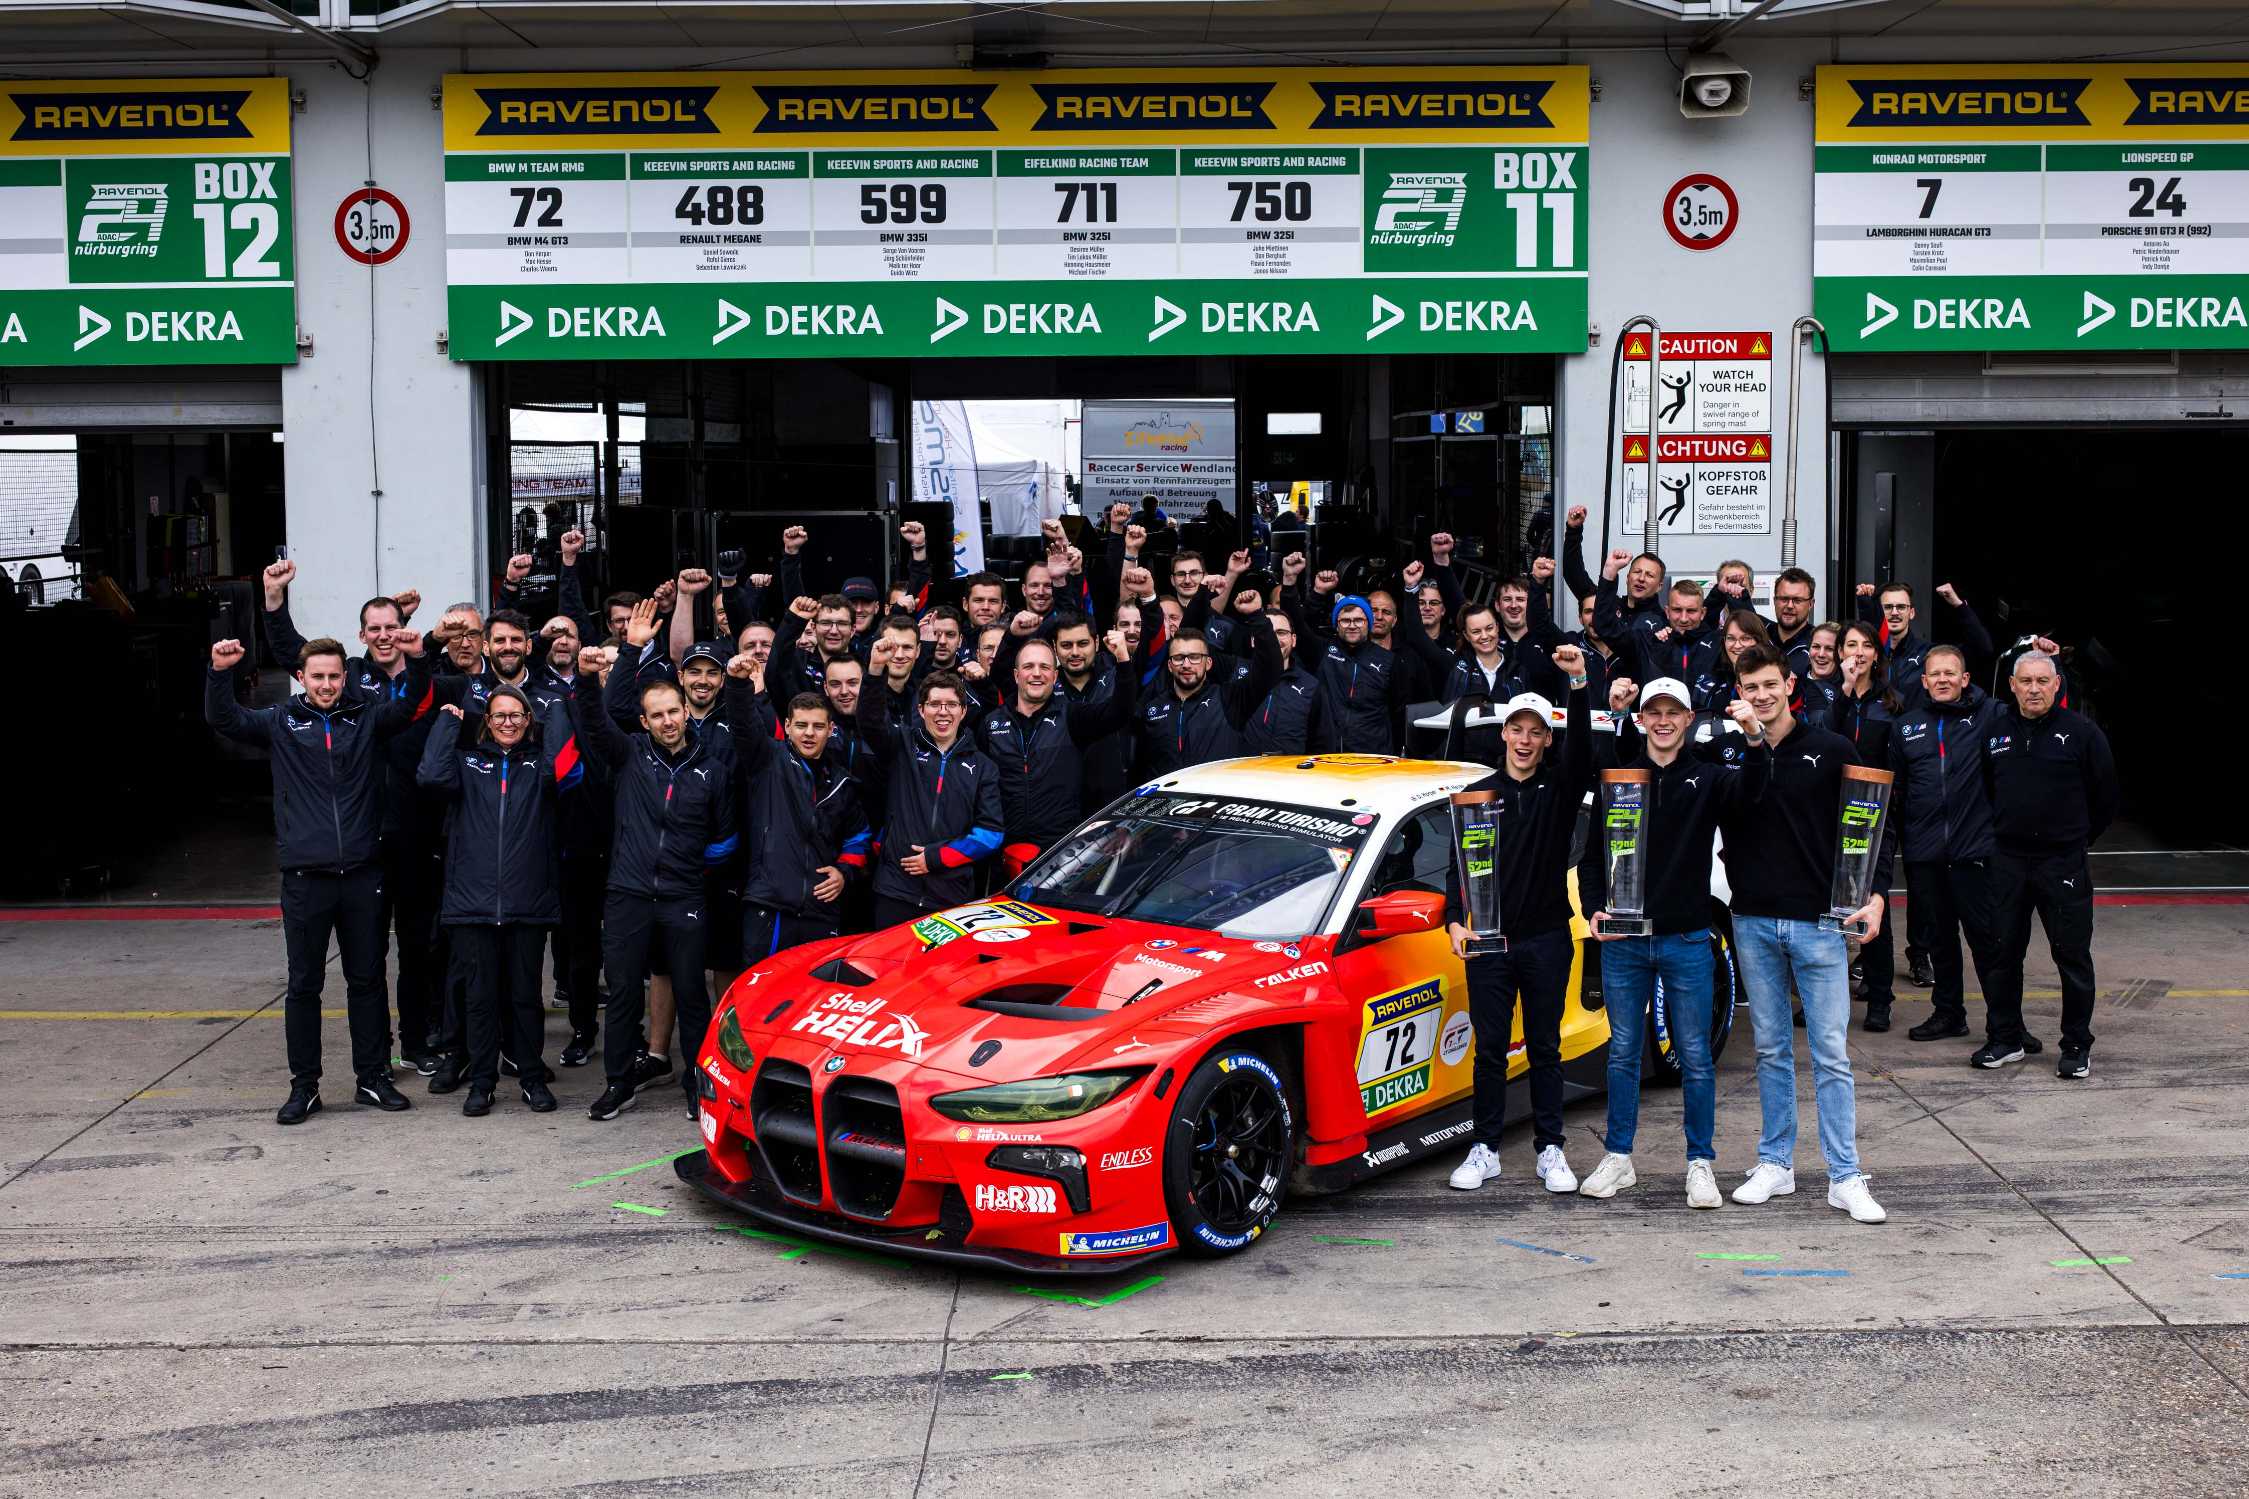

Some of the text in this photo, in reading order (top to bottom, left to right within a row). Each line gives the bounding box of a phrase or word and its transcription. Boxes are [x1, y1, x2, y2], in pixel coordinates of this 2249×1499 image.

[501, 100, 696, 123] RAVENOL
[779, 97, 974, 121] RAVENOL
[1057, 95, 1252, 118] RAVENOL
[1335, 94, 1531, 117] RAVENOL
[1873, 92, 2068, 114] RAVENOL
[2150, 90, 2249, 113] RAVE
[34, 105, 229, 128] RAVENOL
[489, 163, 584, 173] BMW M TEAM RMG
[644, 161, 795, 172] KEEEVIN SPORTS AND RACING
[828, 159, 978, 170] KEEEVIN SPORTS AND RACING
[1025, 158, 1148, 169] EIFELKIND RACING TEAM
[1195, 156, 1346, 168] KEEEVIN SPORTS AND RACING
[1873, 153, 1986, 165] KONRAD MOTORSPORT
[2122, 152, 2194, 163] LIONSPEED GP
[194, 163, 277, 199] BOX
[1495, 153, 1577, 189] BOX
[98, 186, 162, 195] RAVENOL
[1228, 181, 1311, 222] 750
[1916, 179, 1942, 219] 7
[2129, 177, 2186, 217] 24
[510, 187, 563, 227] 72
[675, 186, 763, 225] 488
[861, 184, 946, 223] 599
[1055, 182, 1117, 223] 711
[1375, 189, 1466, 231] 24
[1679, 196, 1722, 227] 3,5m
[78, 200, 168, 241] 24
[350, 211, 395, 242] 3,5m
[1507, 193, 1574, 268] 11
[2102, 225, 2211, 237] PORSCHE 911 GT3 R (992)
[97, 233, 117, 241] ADAC
[194, 203, 280, 277] 12
[508, 237, 568, 245] BMW M4 GT3
[680, 235, 762, 243] RENAULT MEGANE
[880, 234, 927, 242] BMW 335I
[1063, 232, 1110, 241] BMW 325I
[1247, 231, 1294, 239] BMW 325I
[1370, 232, 1455, 246] nürburgring
[1867, 228, 1991, 237] LAMBORGHINI HURACAN GT3
[75, 243, 157, 257] nürburgring
[548, 306, 666, 337] DEKRA
[766, 304, 884, 336] DEKRA
[983, 303, 1102, 333] DEKRA
[1202, 302, 1320, 333] DEKRA
[1420, 300, 1537, 332] DEKRA
[1914, 298, 2031, 329] DEKRA
[2131, 296, 2248, 328] DEKRA
[126, 311, 243, 341] DEKRA
[1659, 339, 1737, 354] CAUTION
[1713, 370, 1753, 379] WATCH
[1699, 383, 1766, 392] YOUR HEAD
[1703, 401, 1731, 410] Danger
[1703, 410, 1759, 419] swivel range of
[1703, 420, 1726, 428] spring
[1161, 444, 1187, 452] racing
[1154, 477, 1231, 486] Rennfahrzeugen
[1699, 471, 1766, 481] KOPFSTOß
[1168, 489, 1217, 497] Betreuung
[1706, 486, 1758, 496] GEFAHR
[1699, 513, 1760, 521] Schwenkbereich
[1216, 804, 1358, 838] GRAN TURISMO
[1229, 816, 1251, 824] REAL
[1252, 819, 1288, 830] DRIVING
[1289, 826, 1343, 843] SIMULATOR
[924, 921, 954, 946] DEKR
[1134, 953, 1203, 977] Motorsport
[1254, 961, 1328, 988] FALKEN
[820, 993, 889, 1015] Shell
[1378, 986, 1437, 1019] RAVENOL
[791, 1011, 932, 1058] HELIX
[1385, 1021, 1416, 1072] 72
[1238, 1057, 1279, 1085] MICHELIN
[1376, 1071, 1425, 1108] DEKRA
[977, 1130, 1010, 1140] HELIX
[1101, 1147, 1152, 1168] ENDLESS
[976, 1184, 1028, 1212] H&R
[1093, 1230, 1160, 1248] MICHELIN
[1200, 1227, 1245, 1248] MICHELIN
